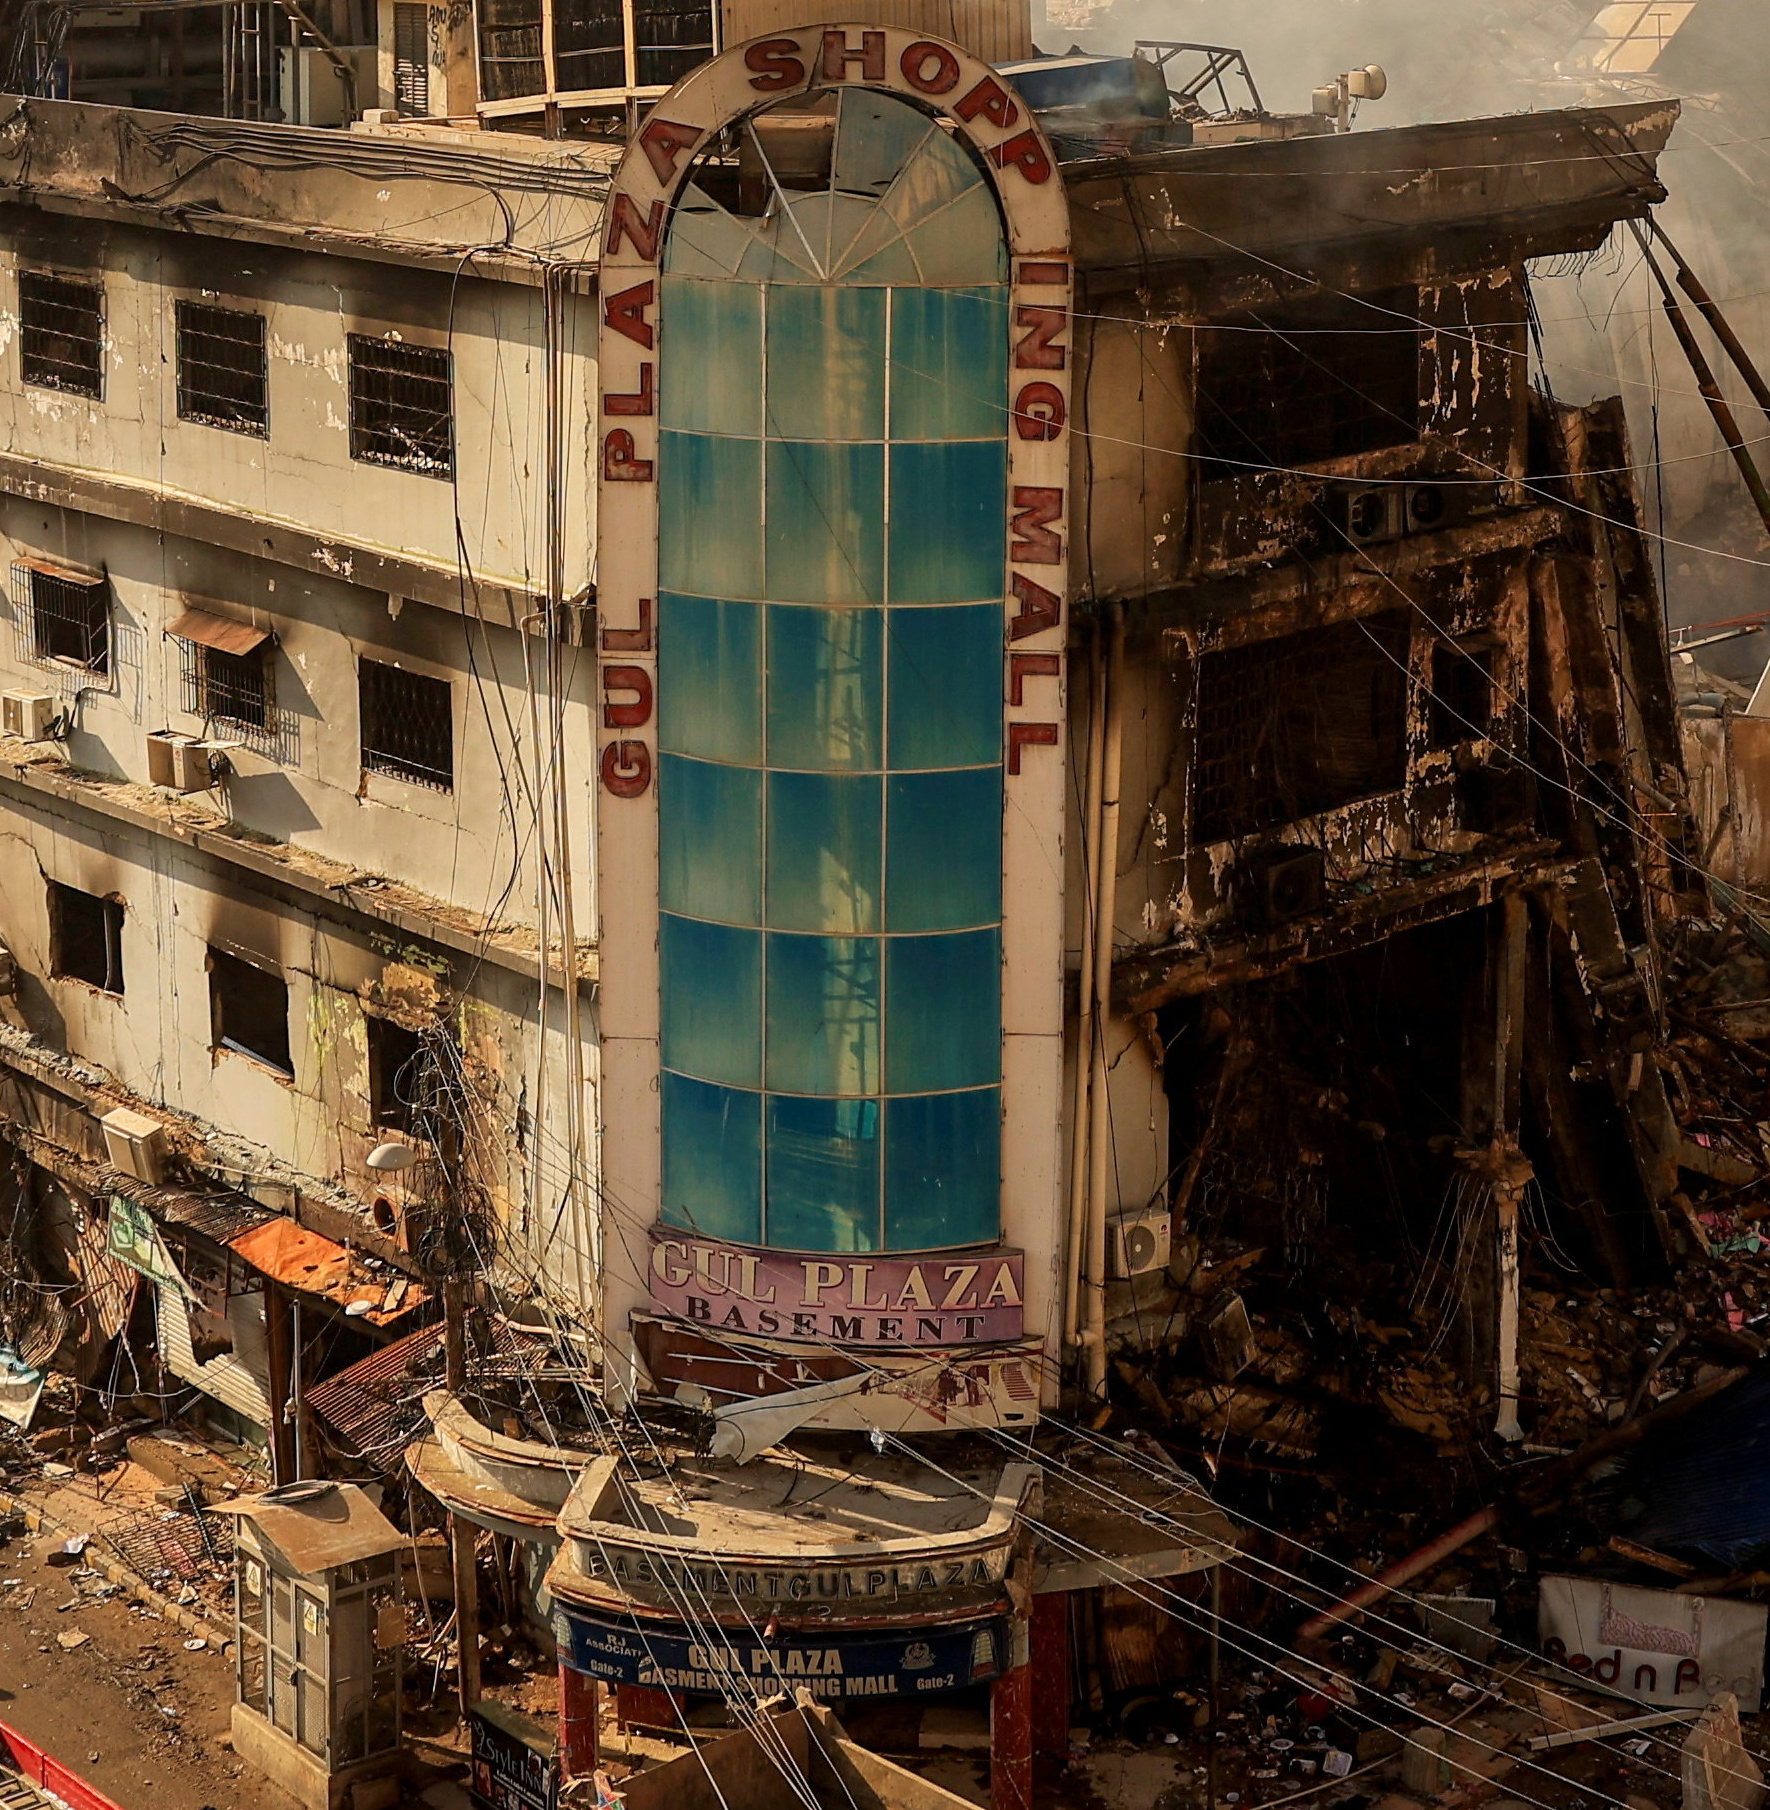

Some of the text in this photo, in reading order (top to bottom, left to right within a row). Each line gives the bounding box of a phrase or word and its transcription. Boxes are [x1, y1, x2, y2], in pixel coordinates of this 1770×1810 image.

[600, 31, 1068, 798] GUL PLAZA SHOPPING MALL
[652, 1240, 1024, 1311] GUL PLAZA
[685, 1294, 987, 1342] BASEMENT
[590, 1658, 624, 1679] Gate-2
[688, 1644, 844, 1676] GUL PLAZA
[845, 1673, 899, 1697] MALL
[917, 1673, 955, 1691] Gate-2
[1635, 1664, 1657, 1693] n
